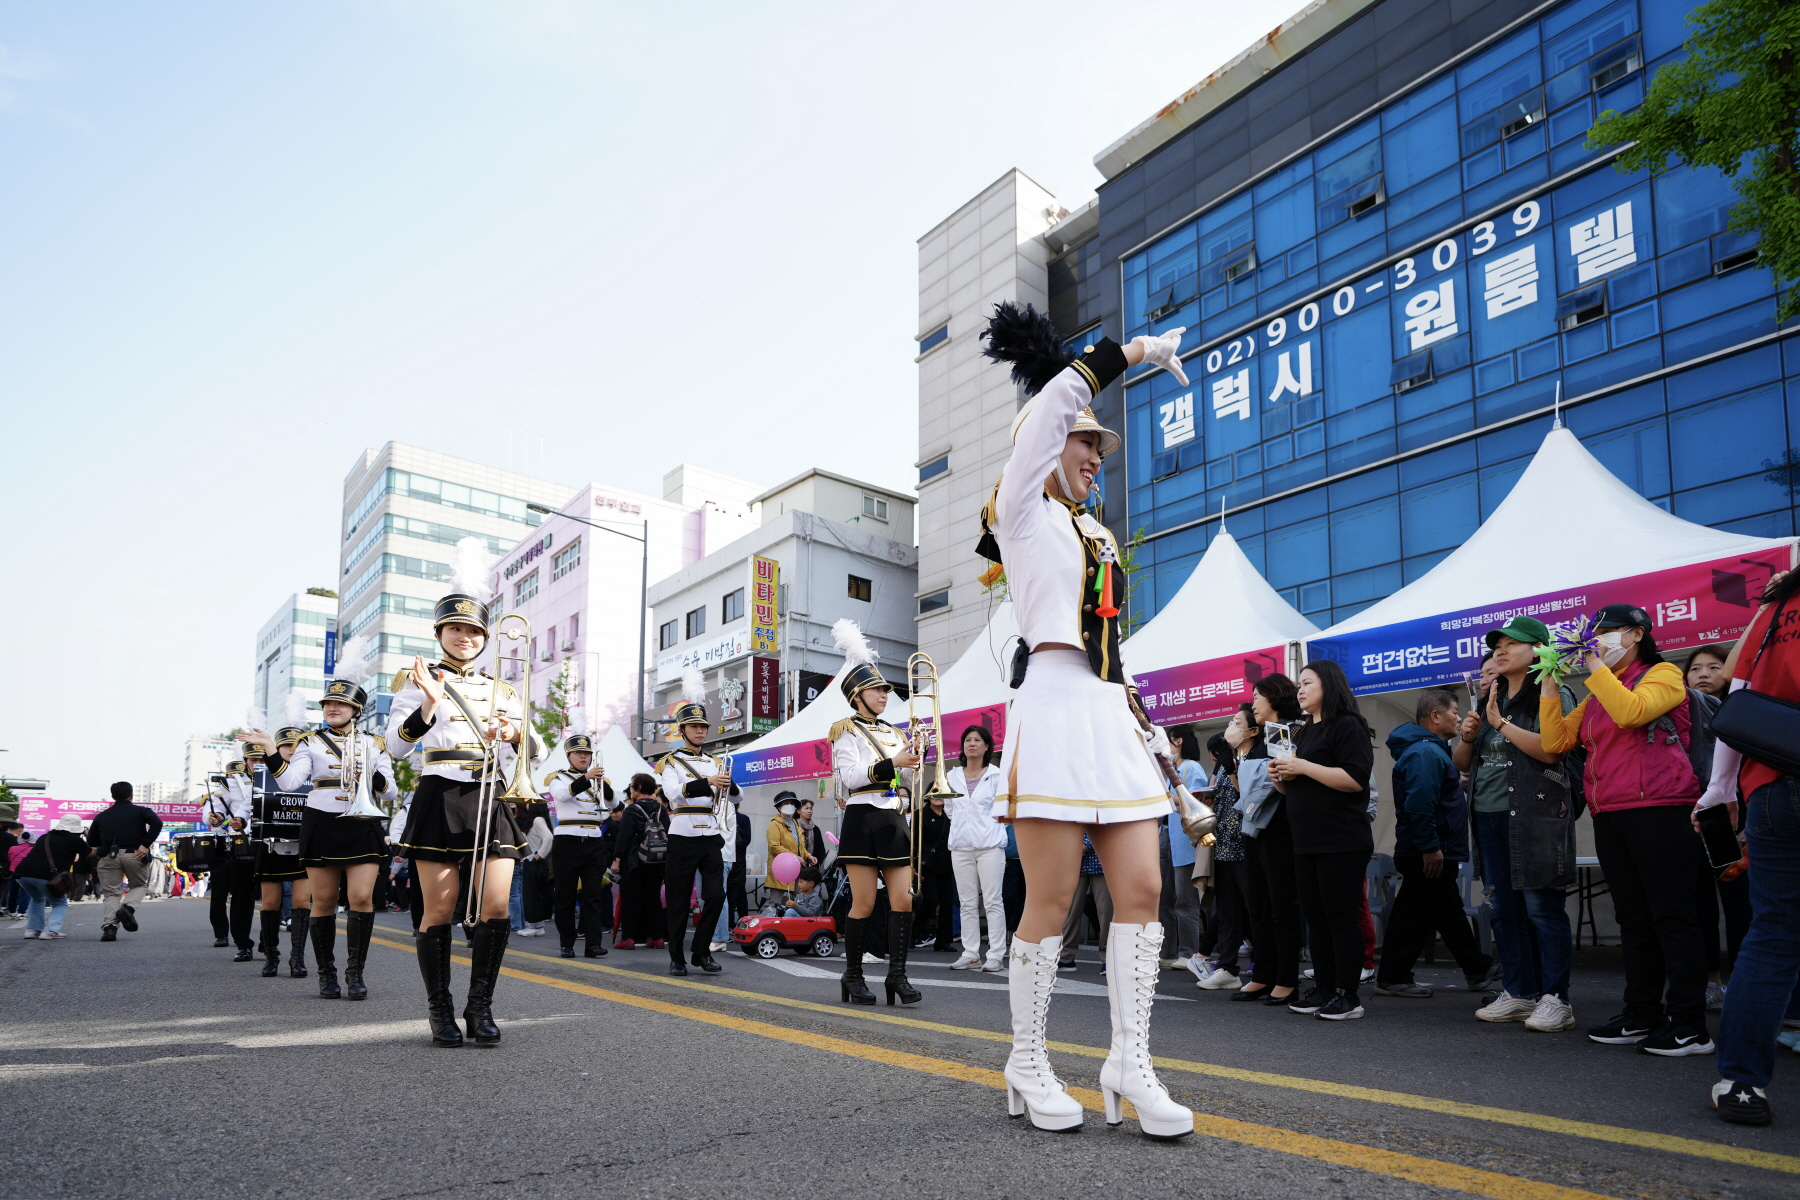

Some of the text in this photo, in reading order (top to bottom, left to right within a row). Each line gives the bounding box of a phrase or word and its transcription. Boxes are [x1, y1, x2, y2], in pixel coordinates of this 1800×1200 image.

[1206, 200, 1541, 374] 02)900-3039
[1159, 200, 1637, 449] 갤럭시 원룸텔
[756, 559, 775, 626] 비타민
[1440, 595, 1587, 631] 희망강북장애인자립생활센터
[754, 626, 775, 642] 주점
[759, 641, 769, 650] B1
[1362, 644, 1450, 675] 편견없는
[1142, 678, 1245, 710] 류 재생 프로젝트
[767, 755, 795, 771] 탄소중립
